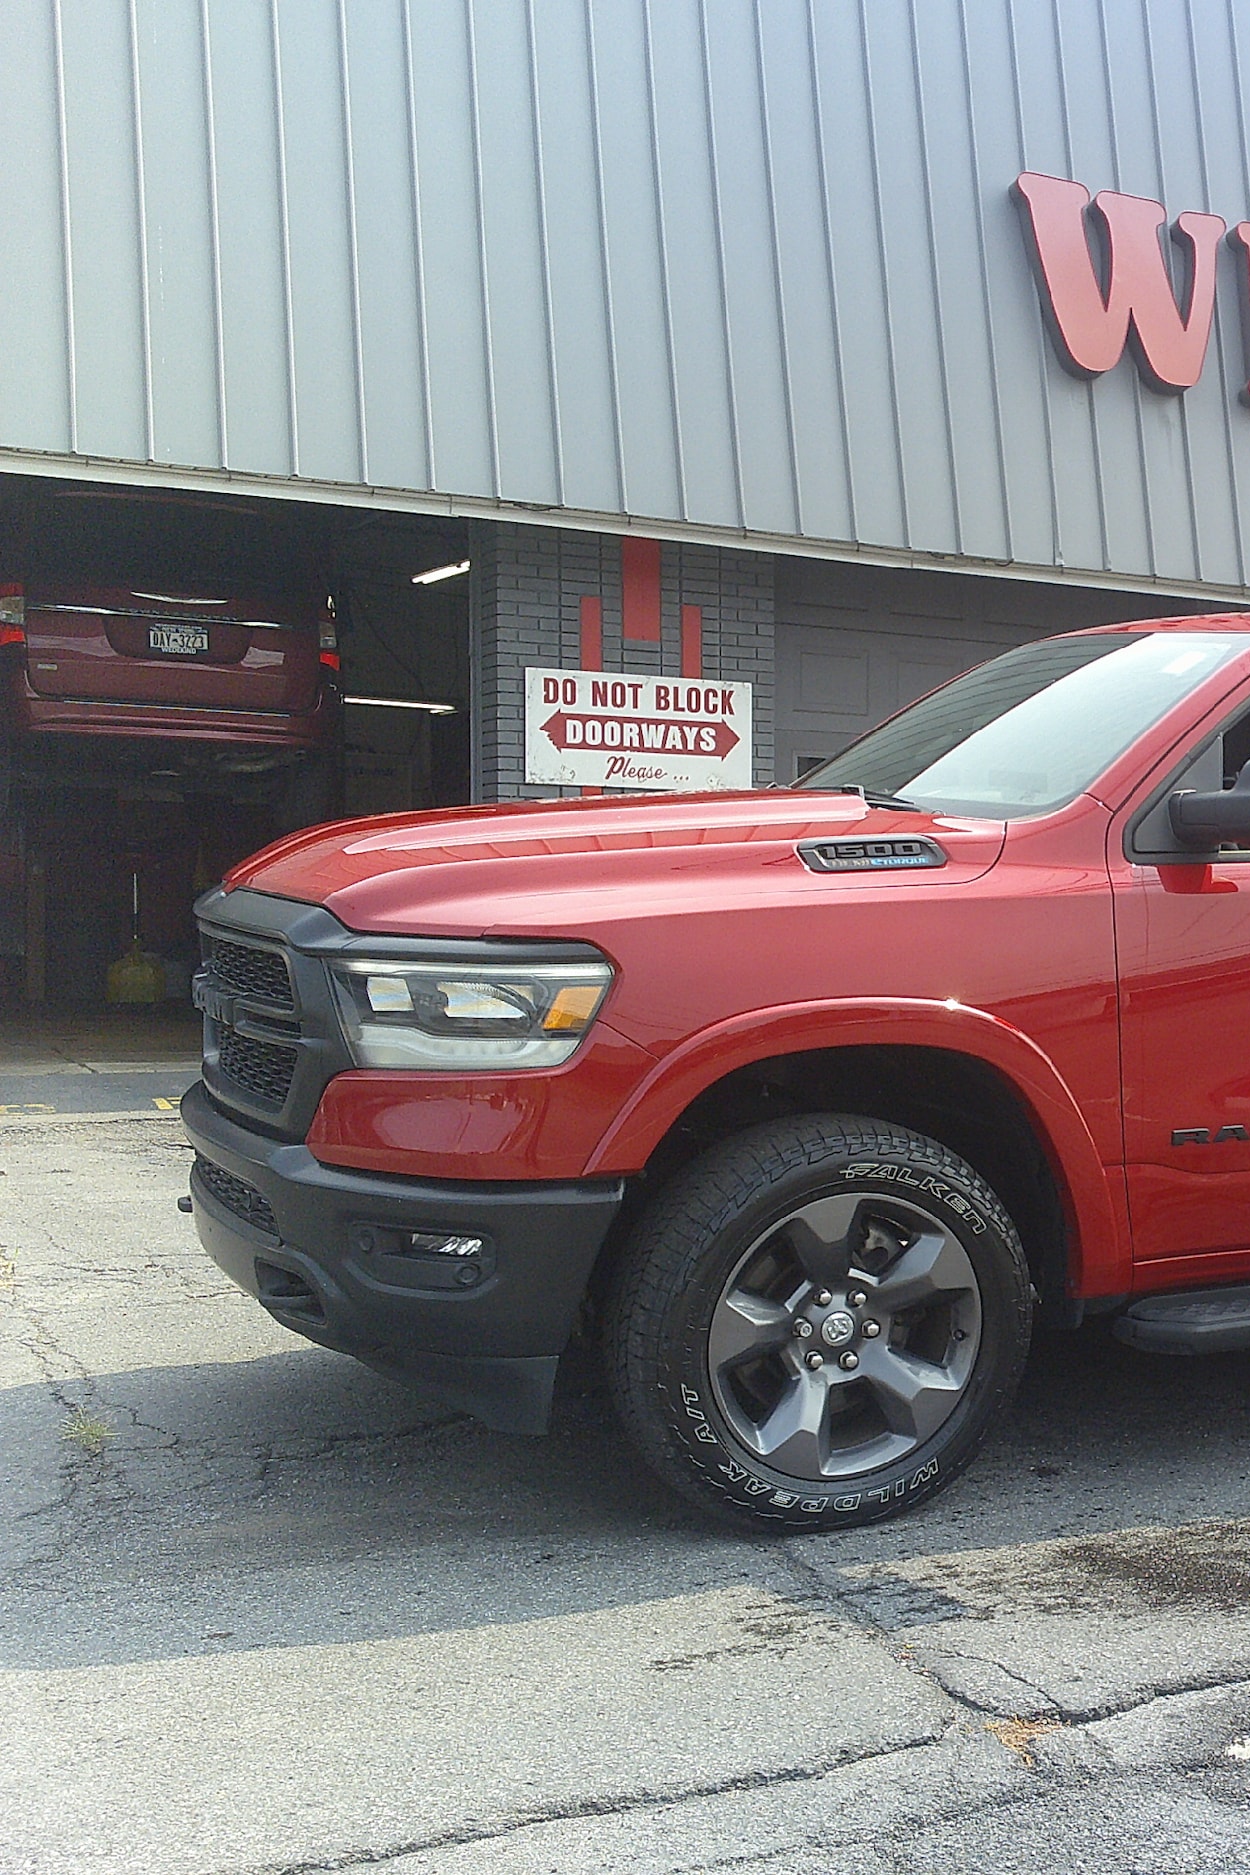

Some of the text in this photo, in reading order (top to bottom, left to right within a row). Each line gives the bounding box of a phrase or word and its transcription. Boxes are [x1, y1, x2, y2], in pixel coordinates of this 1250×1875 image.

[153, 631, 204, 648] DAY 3223
[161, 646, 197, 655] WEDEKIND
[543, 677, 735, 715] DO NOT BLOCK
[565, 719, 717, 752] DOORWAYS
[605, 756, 668, 783] Please
[822, 842, 923, 859] 1500
[840, 1162, 988, 1236] FALKEN
[718, 1456, 940, 1513] WILDPEAK
